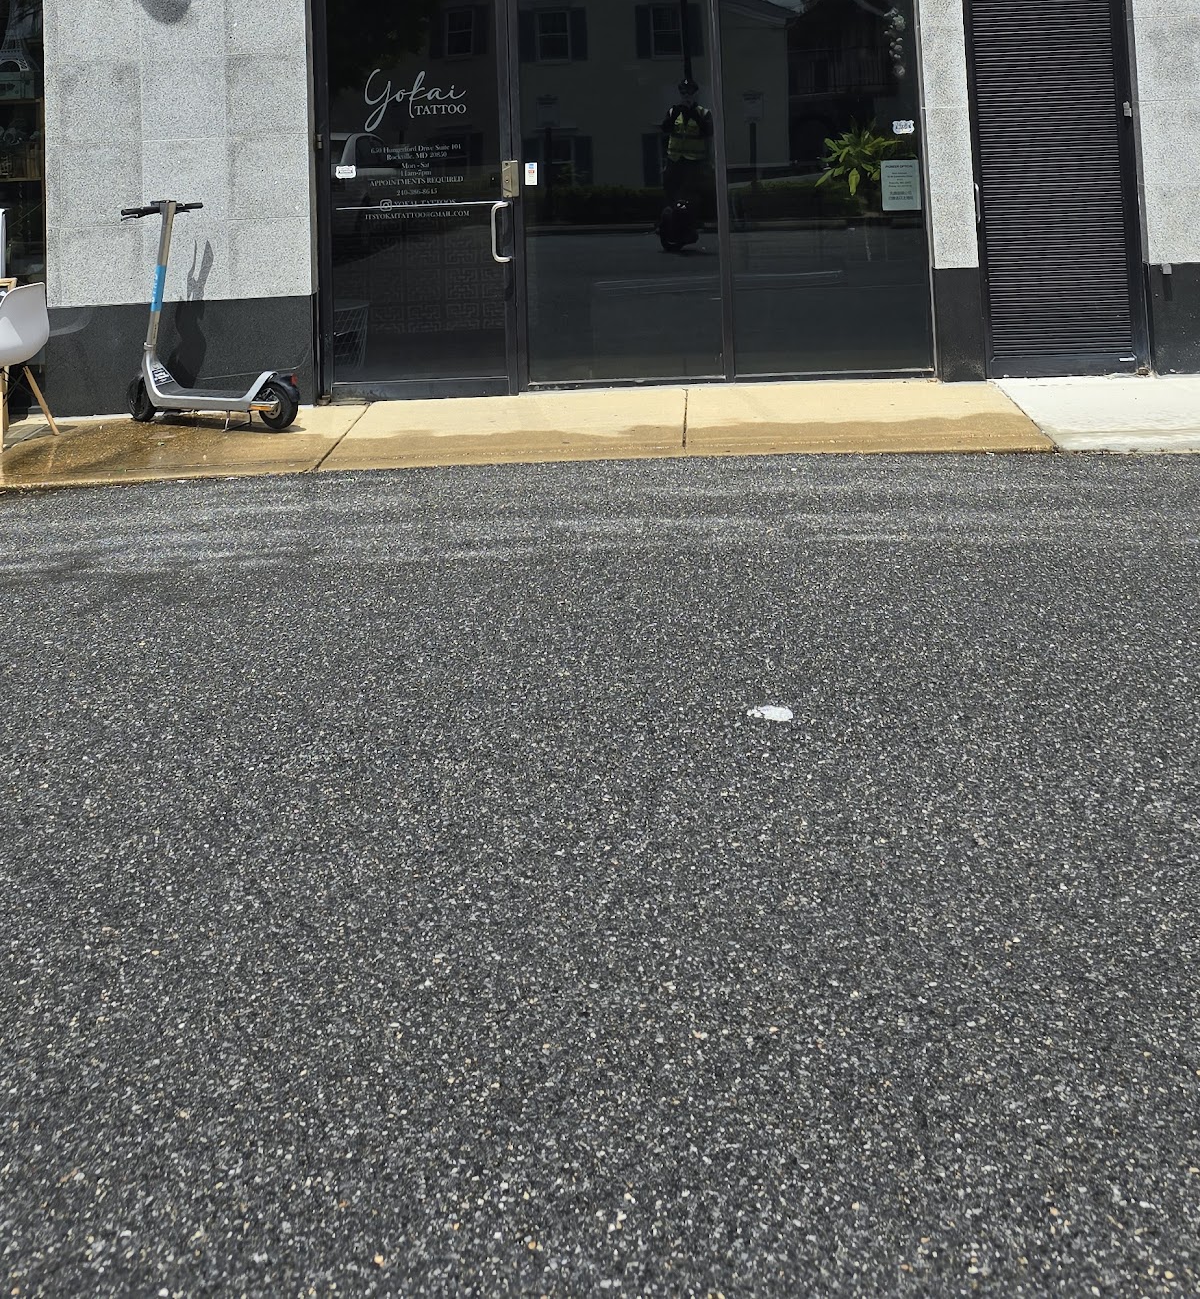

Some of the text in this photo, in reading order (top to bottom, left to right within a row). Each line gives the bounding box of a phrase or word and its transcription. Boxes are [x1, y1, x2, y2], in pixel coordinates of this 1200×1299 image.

[365, 68, 467, 132] Yokai
[414, 103, 467, 116] TATTOO
[418, 144, 433, 152] Drive
[435, 143, 450, 151] Suite
[370, 175, 464, 187] APPOINTMENTS REQUIRED
